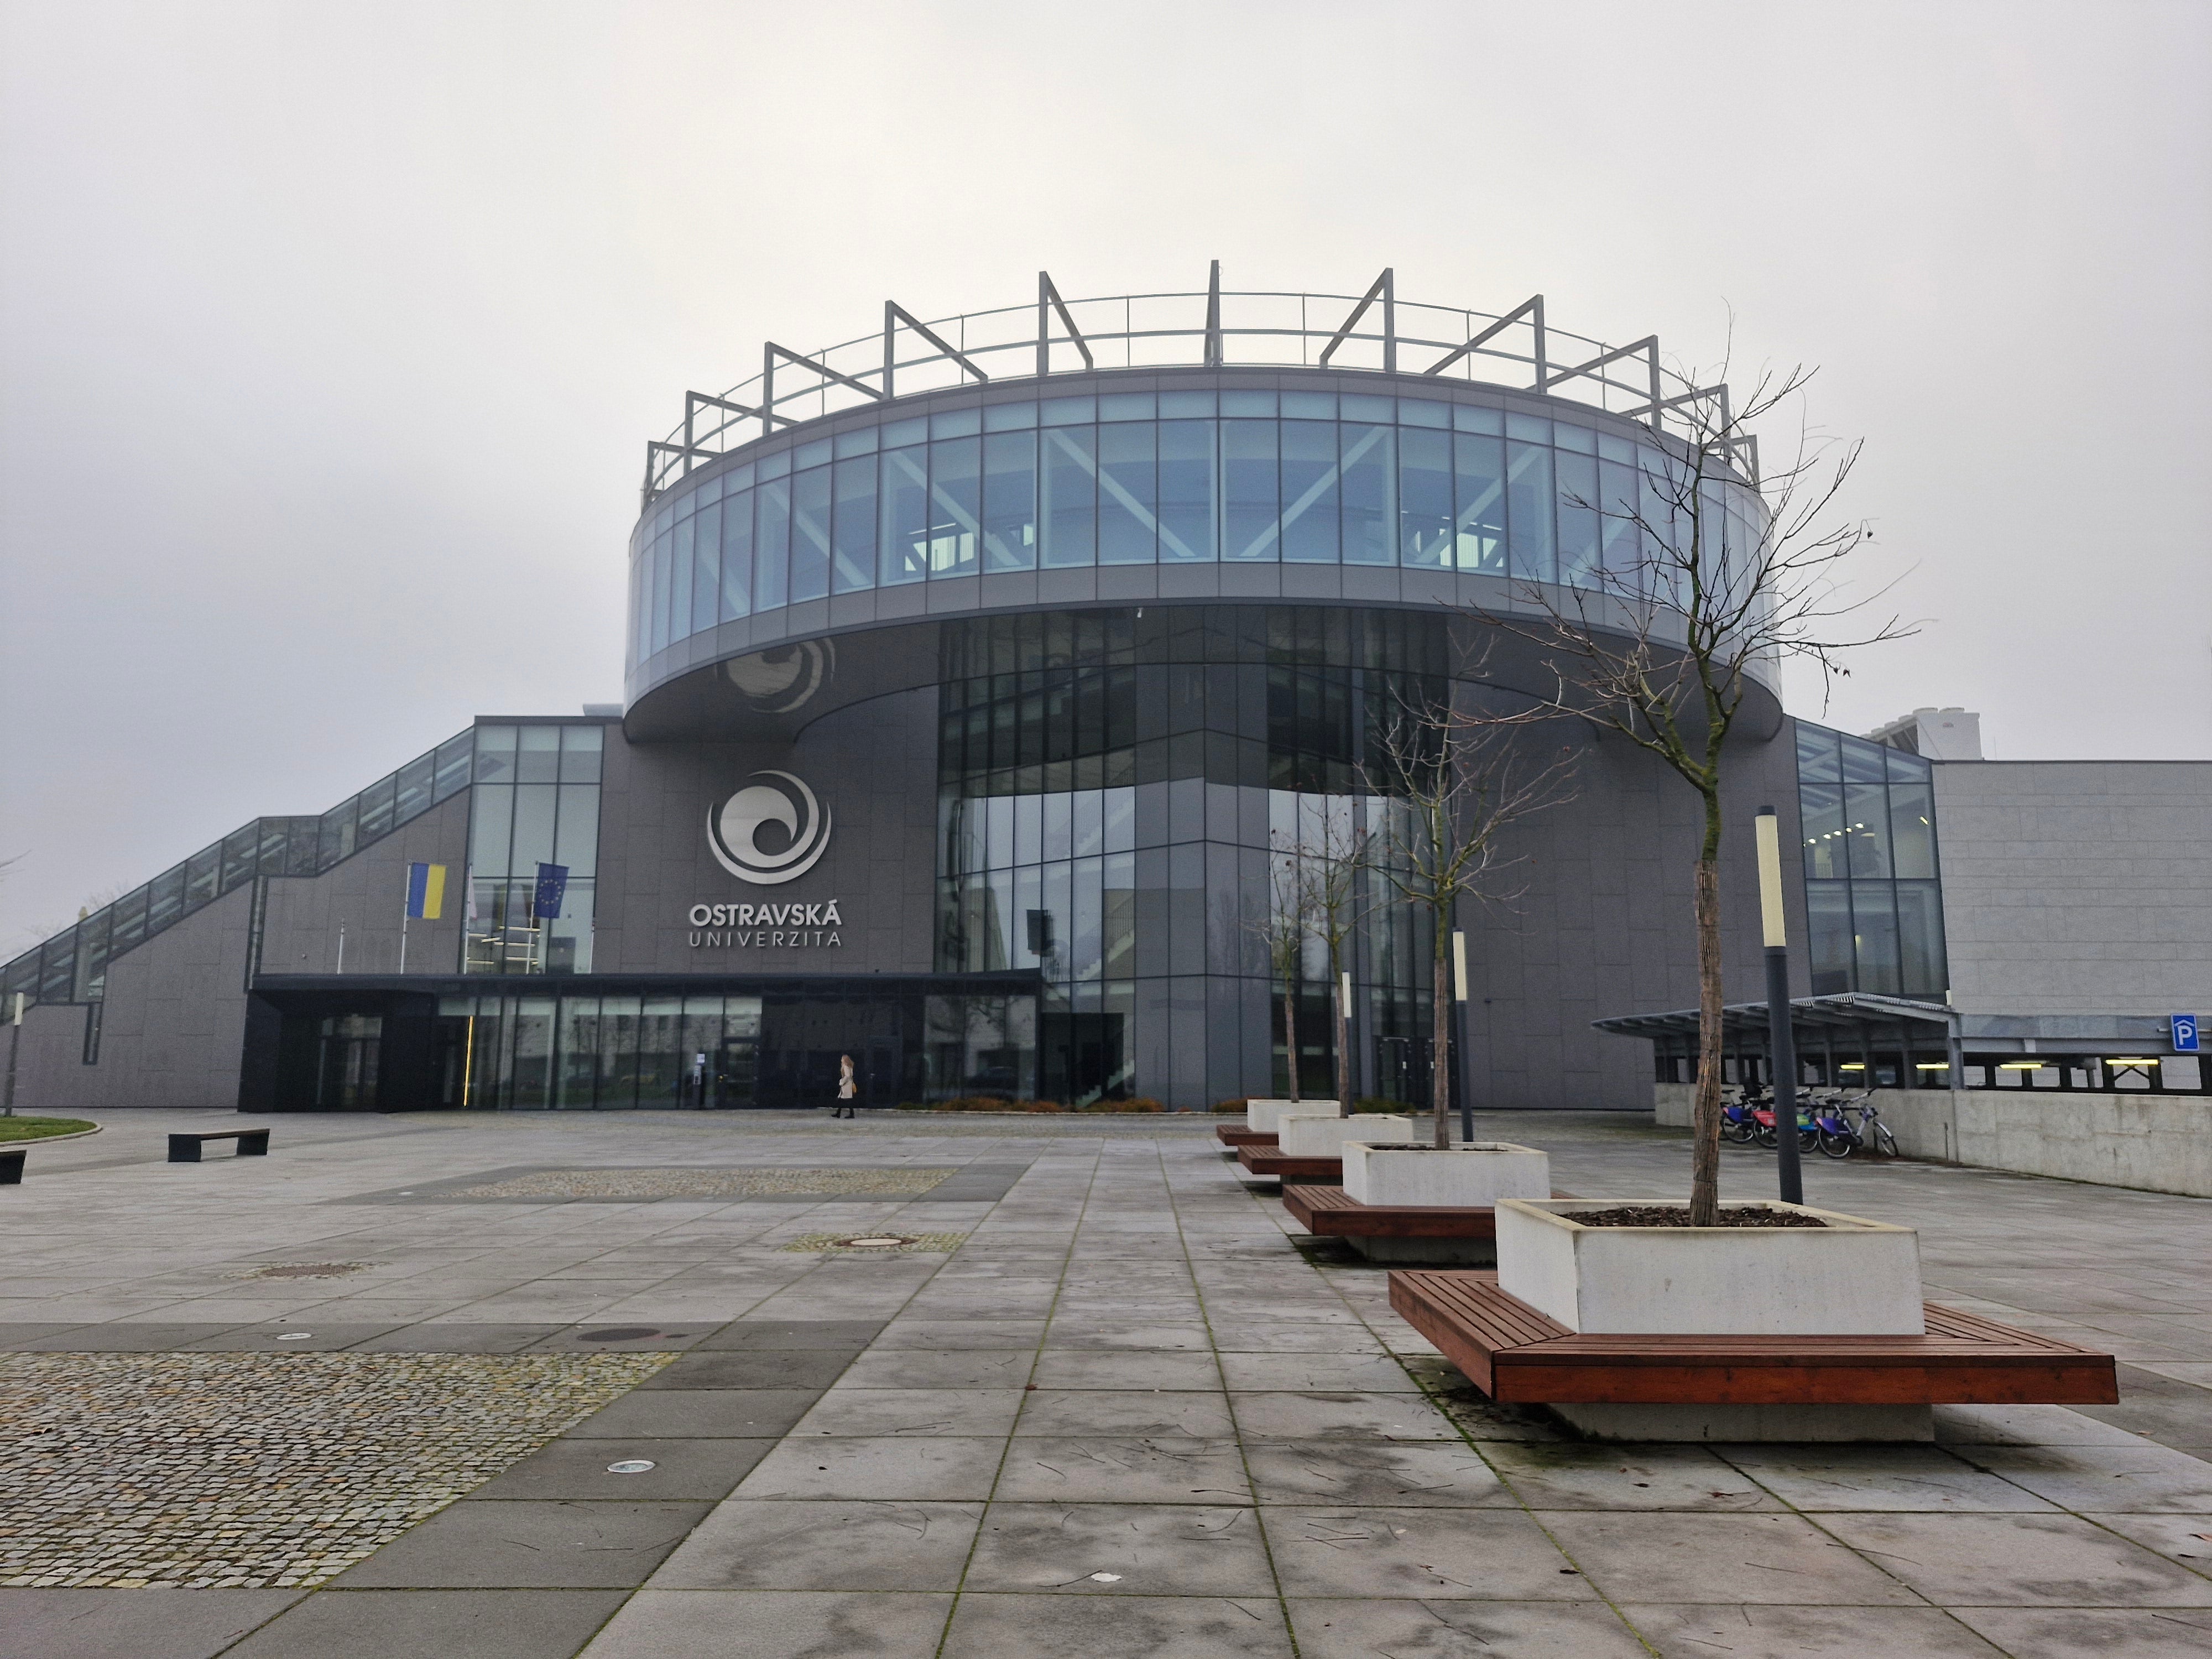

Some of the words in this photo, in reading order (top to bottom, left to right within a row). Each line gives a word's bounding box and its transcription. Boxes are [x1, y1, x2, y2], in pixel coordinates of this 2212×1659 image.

[690, 899, 841, 926] OSTRAVSKÁ
[690, 931, 841, 946] UNIVERZITA
[2178, 1025, 2193, 1045] P
